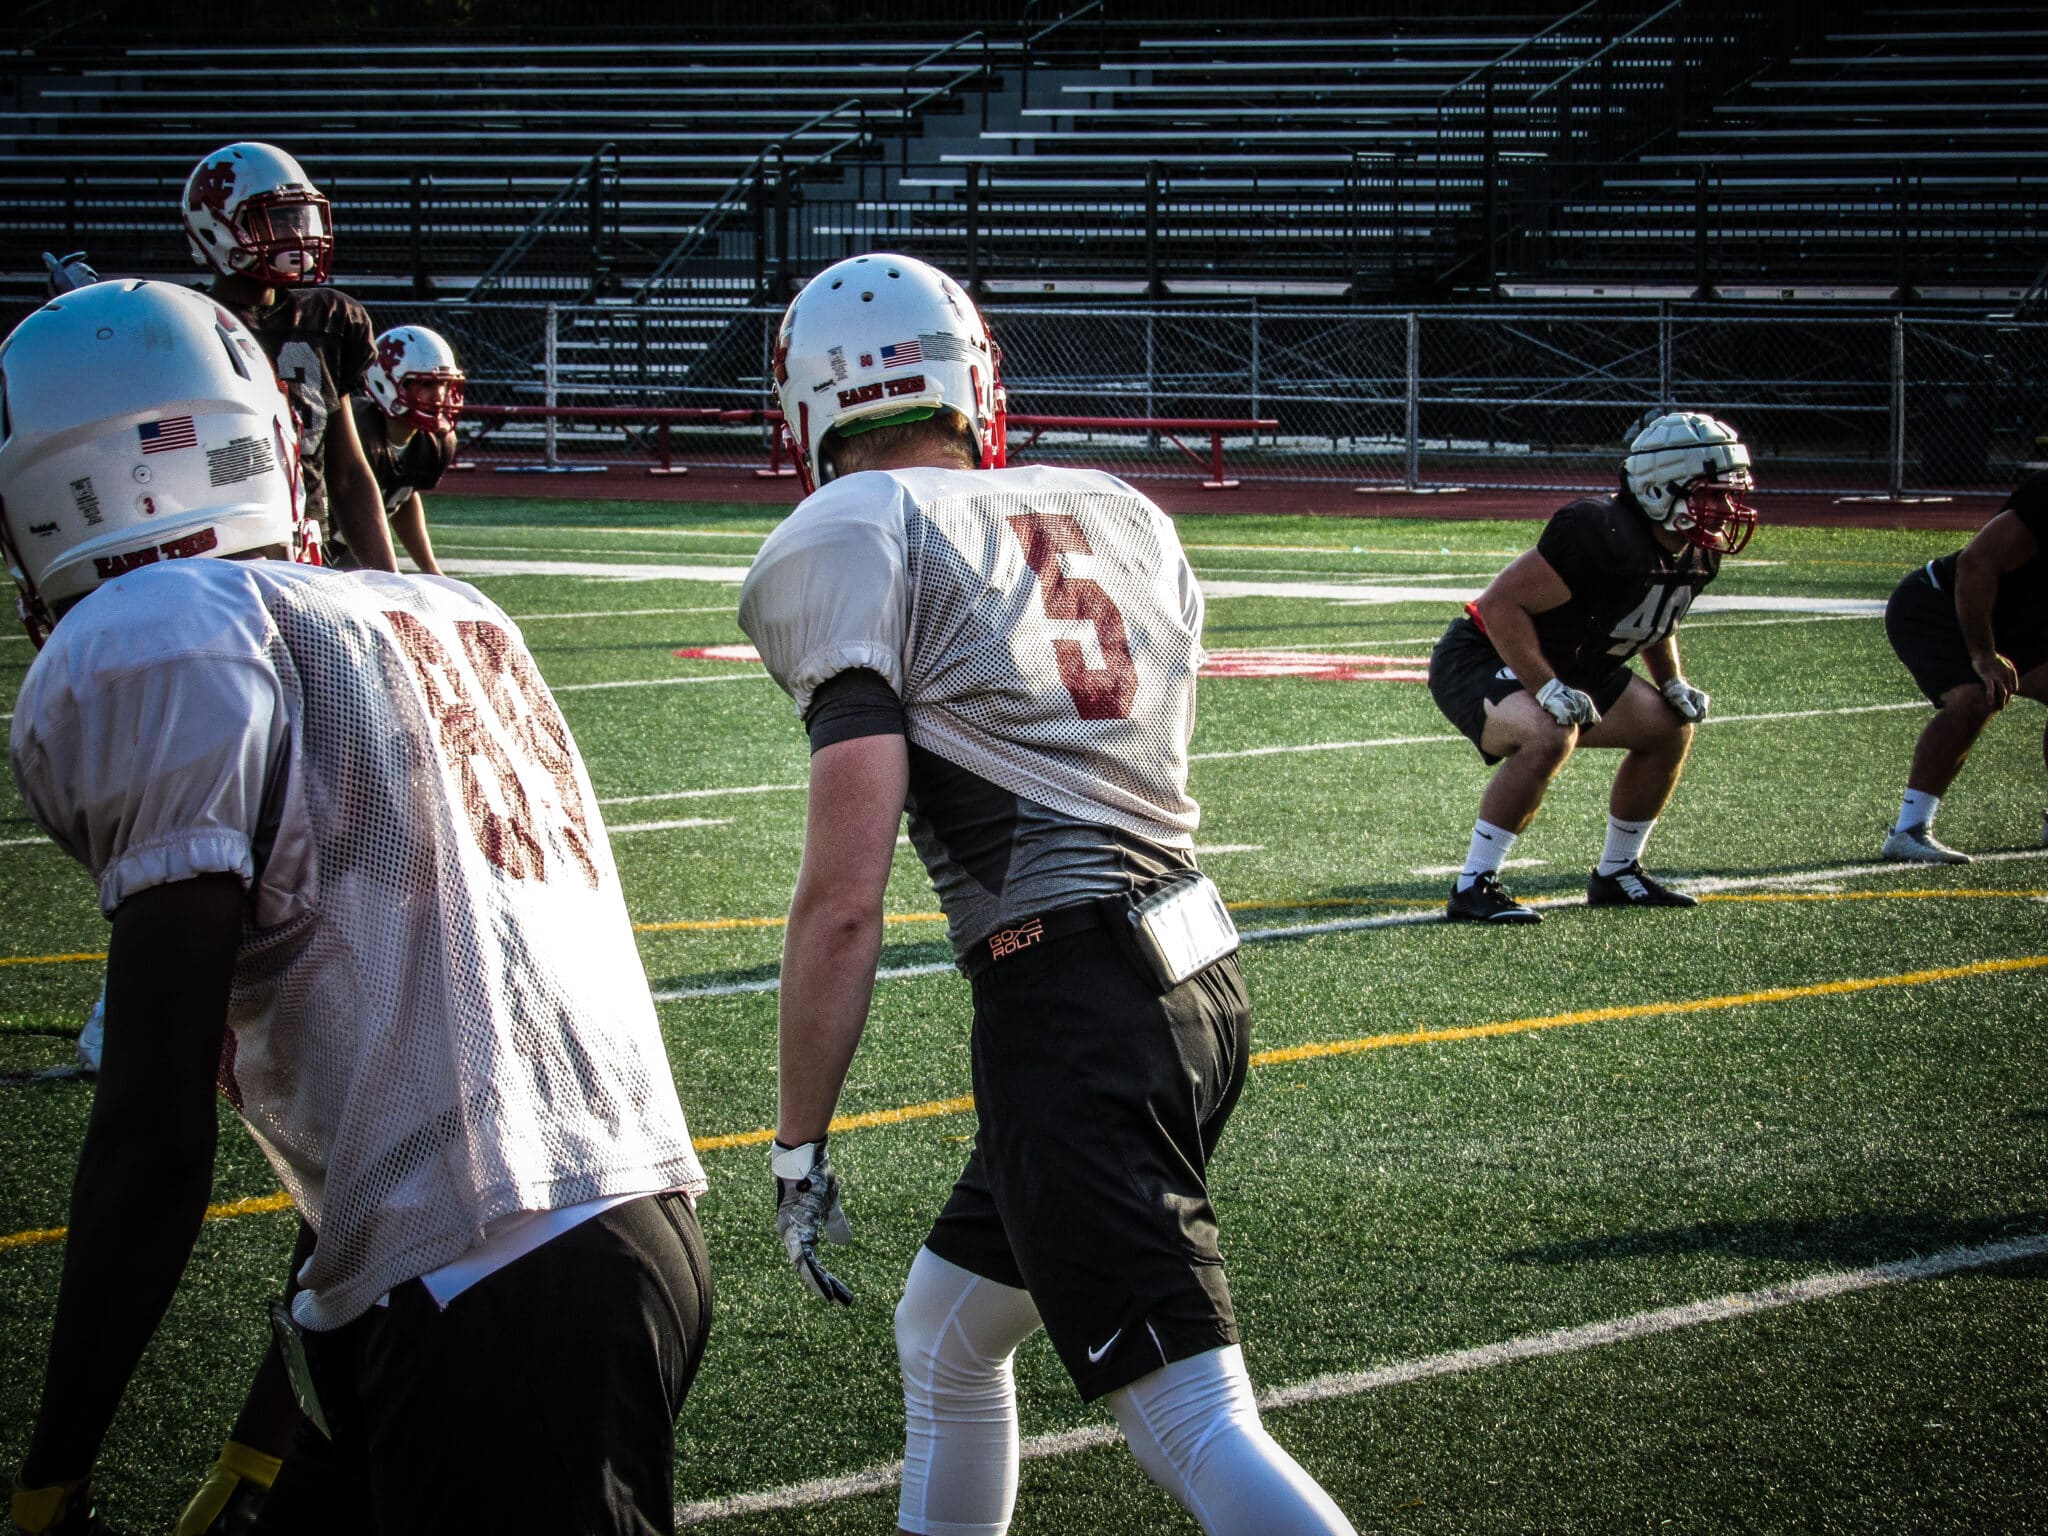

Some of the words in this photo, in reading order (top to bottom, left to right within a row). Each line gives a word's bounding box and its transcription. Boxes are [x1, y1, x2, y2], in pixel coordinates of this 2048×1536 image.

[1006, 512, 1139, 721] 5
[1607, 584, 1692, 656] 40
[1615, 874, 1649, 900] NIKE
